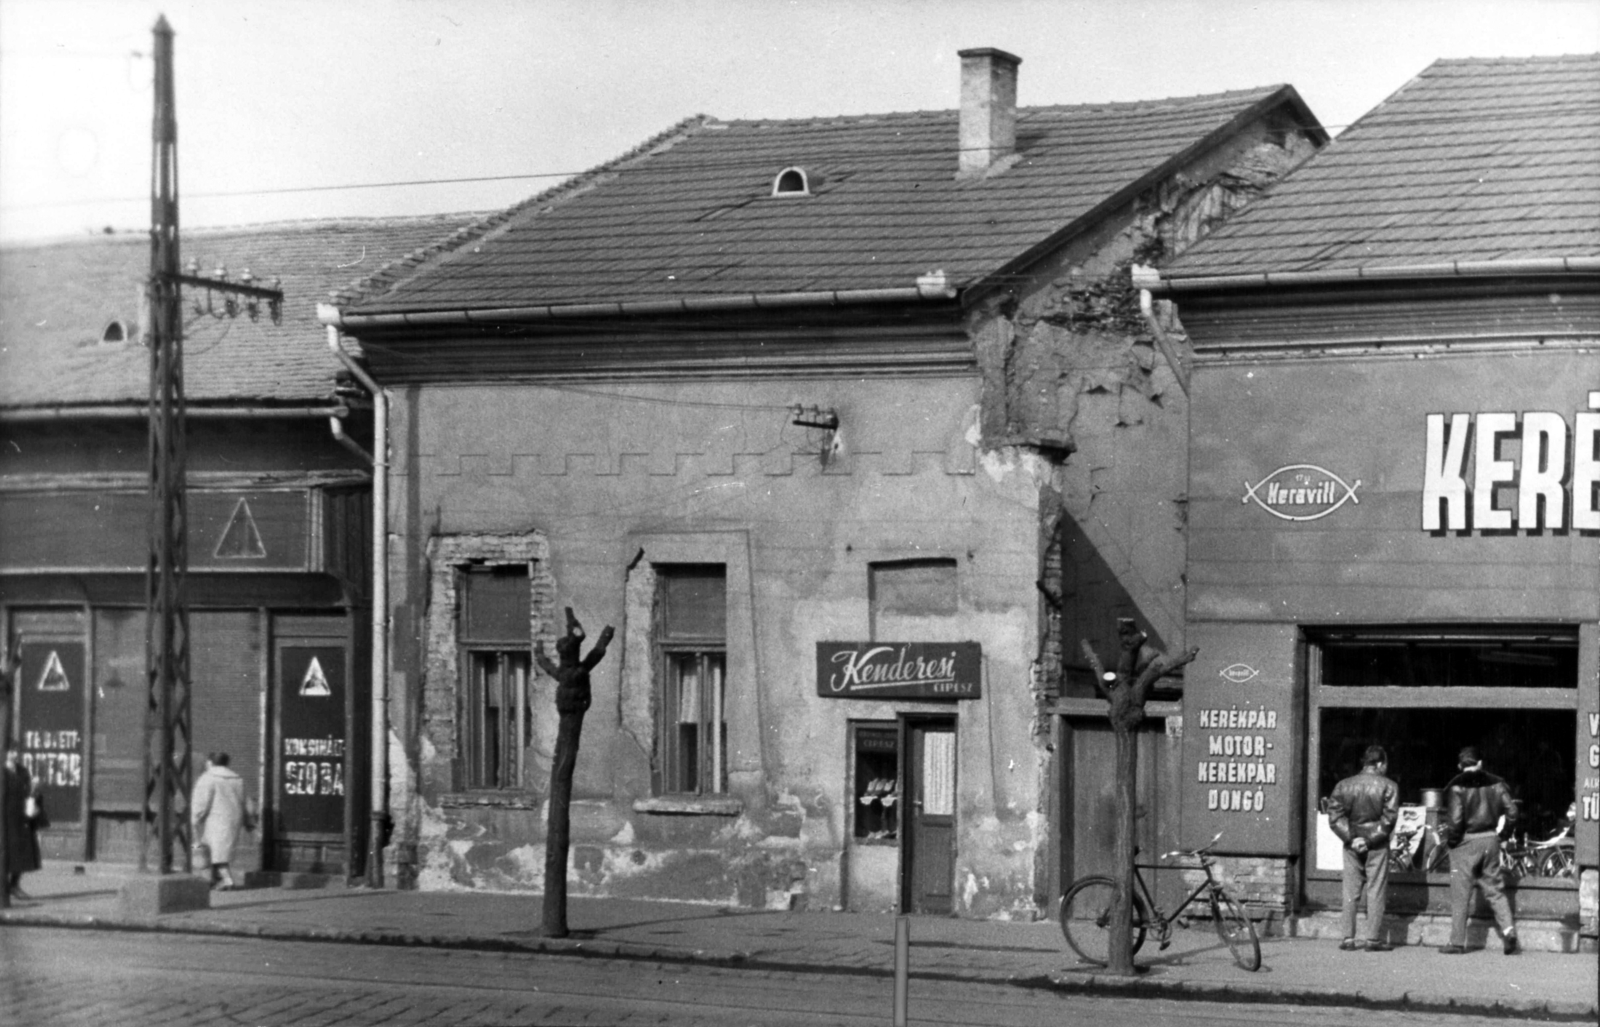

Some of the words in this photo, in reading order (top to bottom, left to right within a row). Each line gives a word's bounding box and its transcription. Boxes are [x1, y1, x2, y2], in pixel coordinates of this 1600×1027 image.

[1422, 391, 1600, 530] KERÉ
[1267, 481, 1335, 505] Keravill
[831, 646, 956, 692] Kenderesi
[1200, 705, 1277, 728] KERÉKPÁR
[1209, 735, 1273, 757] MOTOR-
[284, 761, 345, 797] SZOBA
[1198, 758, 1277, 784] KERÉKPÁR
[1208, 785, 1265, 812] DONGÓ
